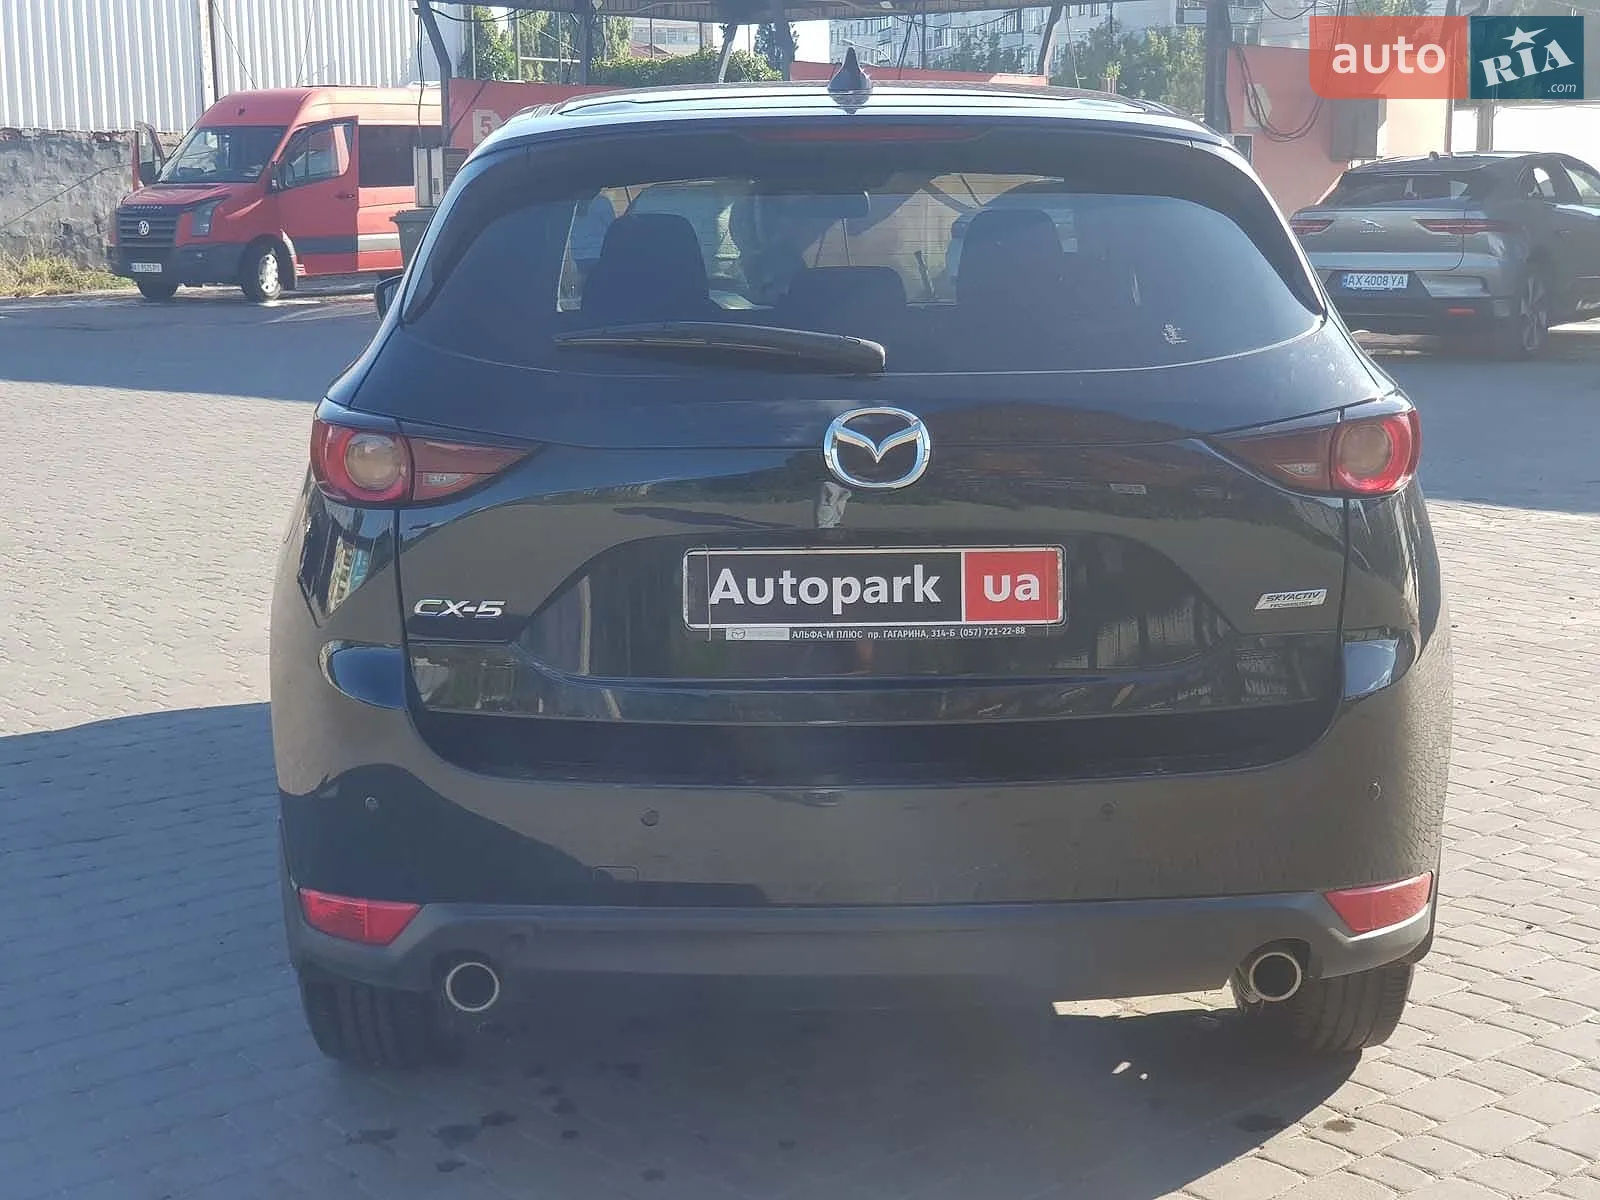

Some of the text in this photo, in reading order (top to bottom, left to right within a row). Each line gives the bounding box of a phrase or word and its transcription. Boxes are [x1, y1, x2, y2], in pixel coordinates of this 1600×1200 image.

[1364, 275, 1389, 286] 4008
[709, 564, 941, 615] Autopark
[983, 572, 1040, 602] ua
[1266, 591, 1321, 602] SKYACTIV
[413, 599, 506, 619] CX-5
[791, 630, 834, 640] АЛЬФА-М
[836, 630, 863, 640] ПЛЮС
[867, 632, 881, 640] пр.
[883, 629, 929, 640] ГАГАРИНА,
[960, 627, 982, 638] (057)
[983, 626, 1026, 636] 721-22-88
